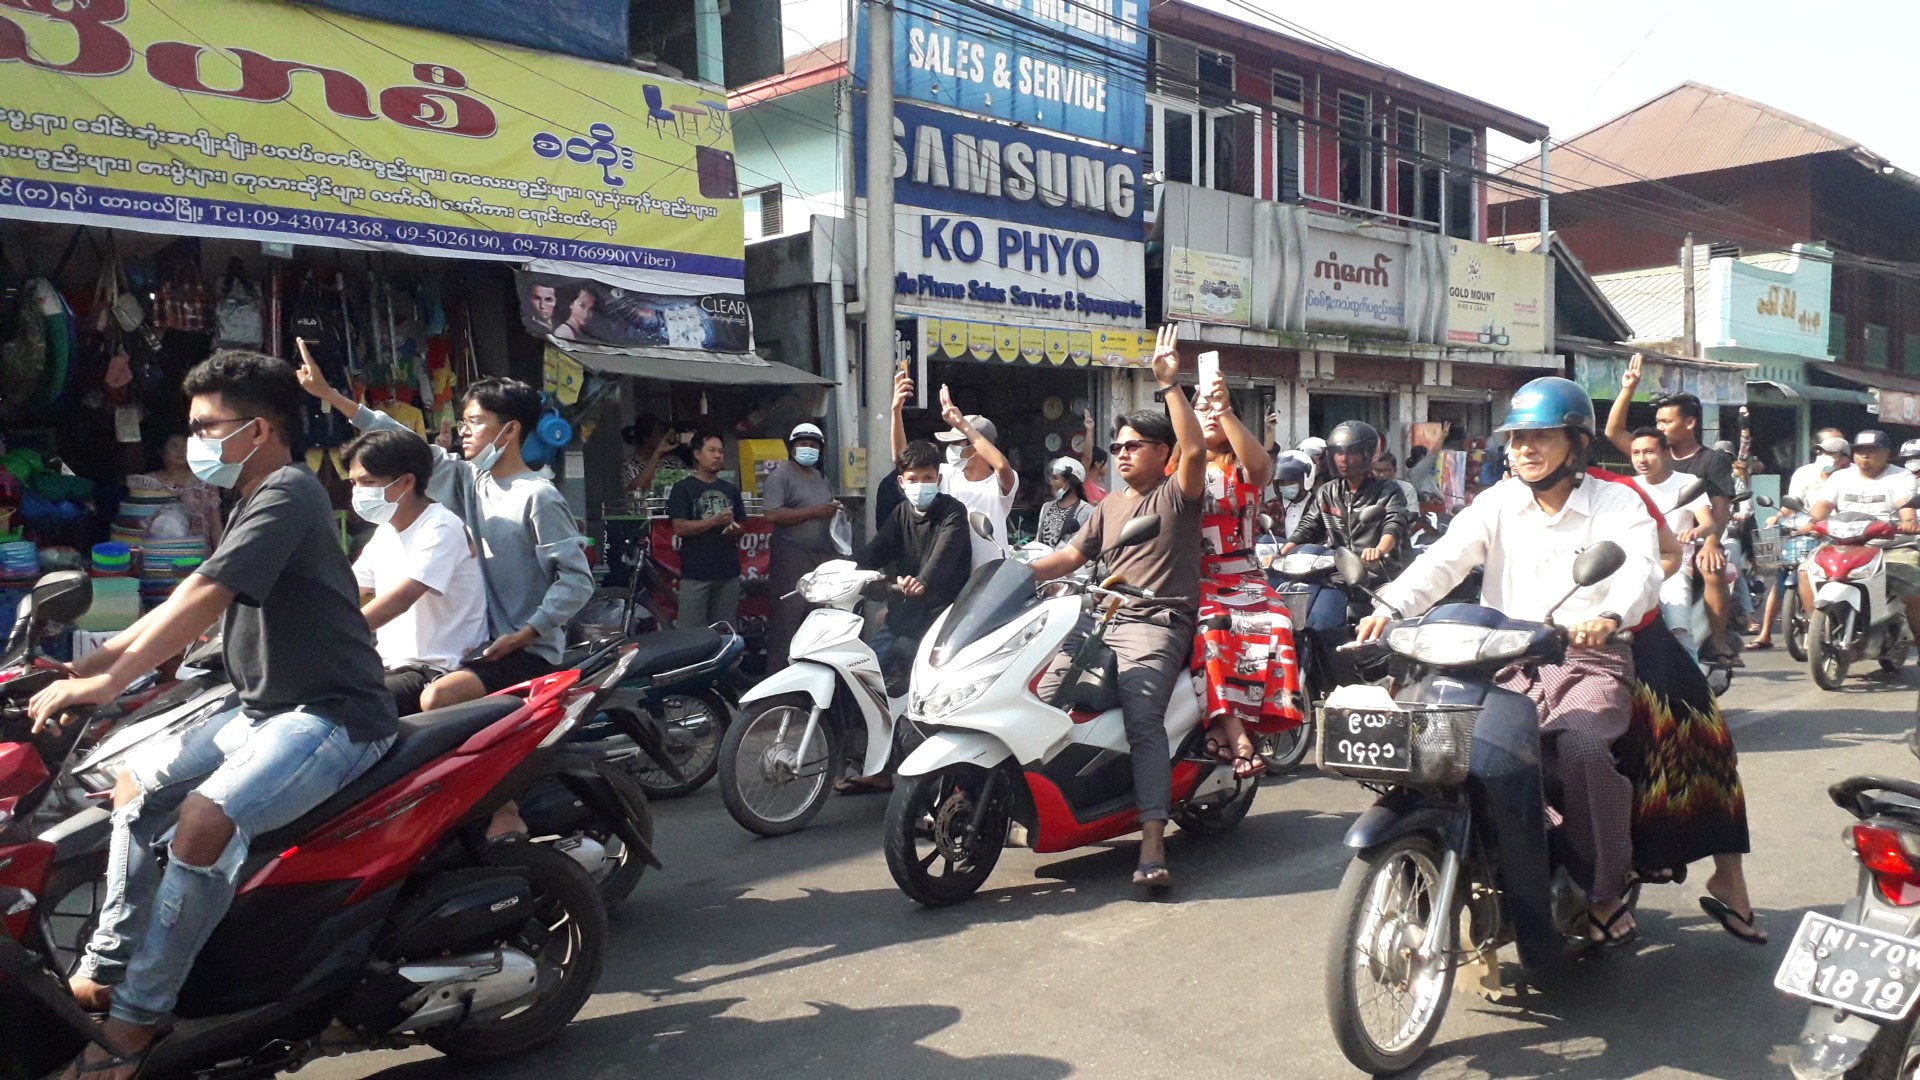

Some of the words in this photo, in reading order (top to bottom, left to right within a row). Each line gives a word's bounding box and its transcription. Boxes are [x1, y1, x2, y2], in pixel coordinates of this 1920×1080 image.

[909, 27, 985, 83] SALES
[993, 52, 1012, 90] &
[1019, 56, 1107, 113] SERVICE
[532, 122, 635, 187] စတိုး
[209, 205, 389, 240] Tel:09-43074368,
[396, 225, 505, 252] 09-5026190,
[922, 215, 984, 263] KO
[998, 226, 1100, 279] PHYO
[700, 296, 746, 315] CLEAR
[918, 273, 966, 300] Phone
[968, 279, 1006, 303] Sales
[1009, 284, 1062, 309] Service
[1064, 290, 1076, 311] &
[1449, 286, 1469, 299] GOLD
[1470, 289, 1496, 302] MOUNT
